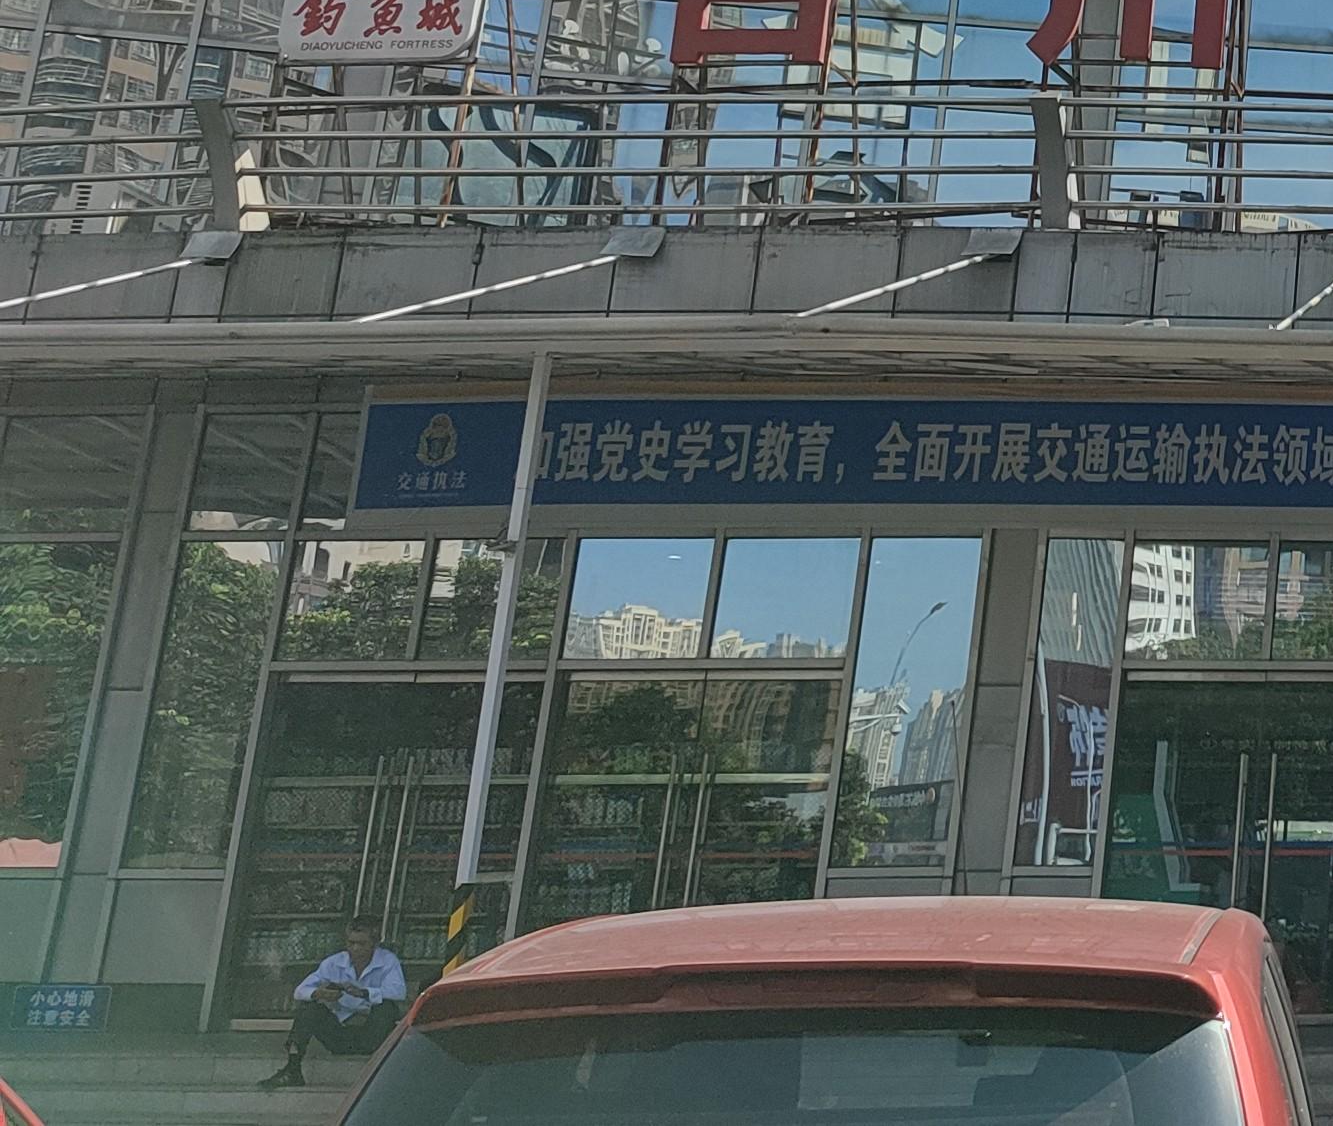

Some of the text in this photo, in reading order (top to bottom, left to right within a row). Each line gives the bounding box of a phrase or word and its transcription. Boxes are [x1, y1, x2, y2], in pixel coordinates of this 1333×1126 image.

[300, 39, 454, 52] DIAOYUCHENG FORTRESS
[396, 470, 468, 491] 交通执法
[29, 990, 96, 1007] 小心地滑
[26, 1009, 92, 1027] 注意安全
